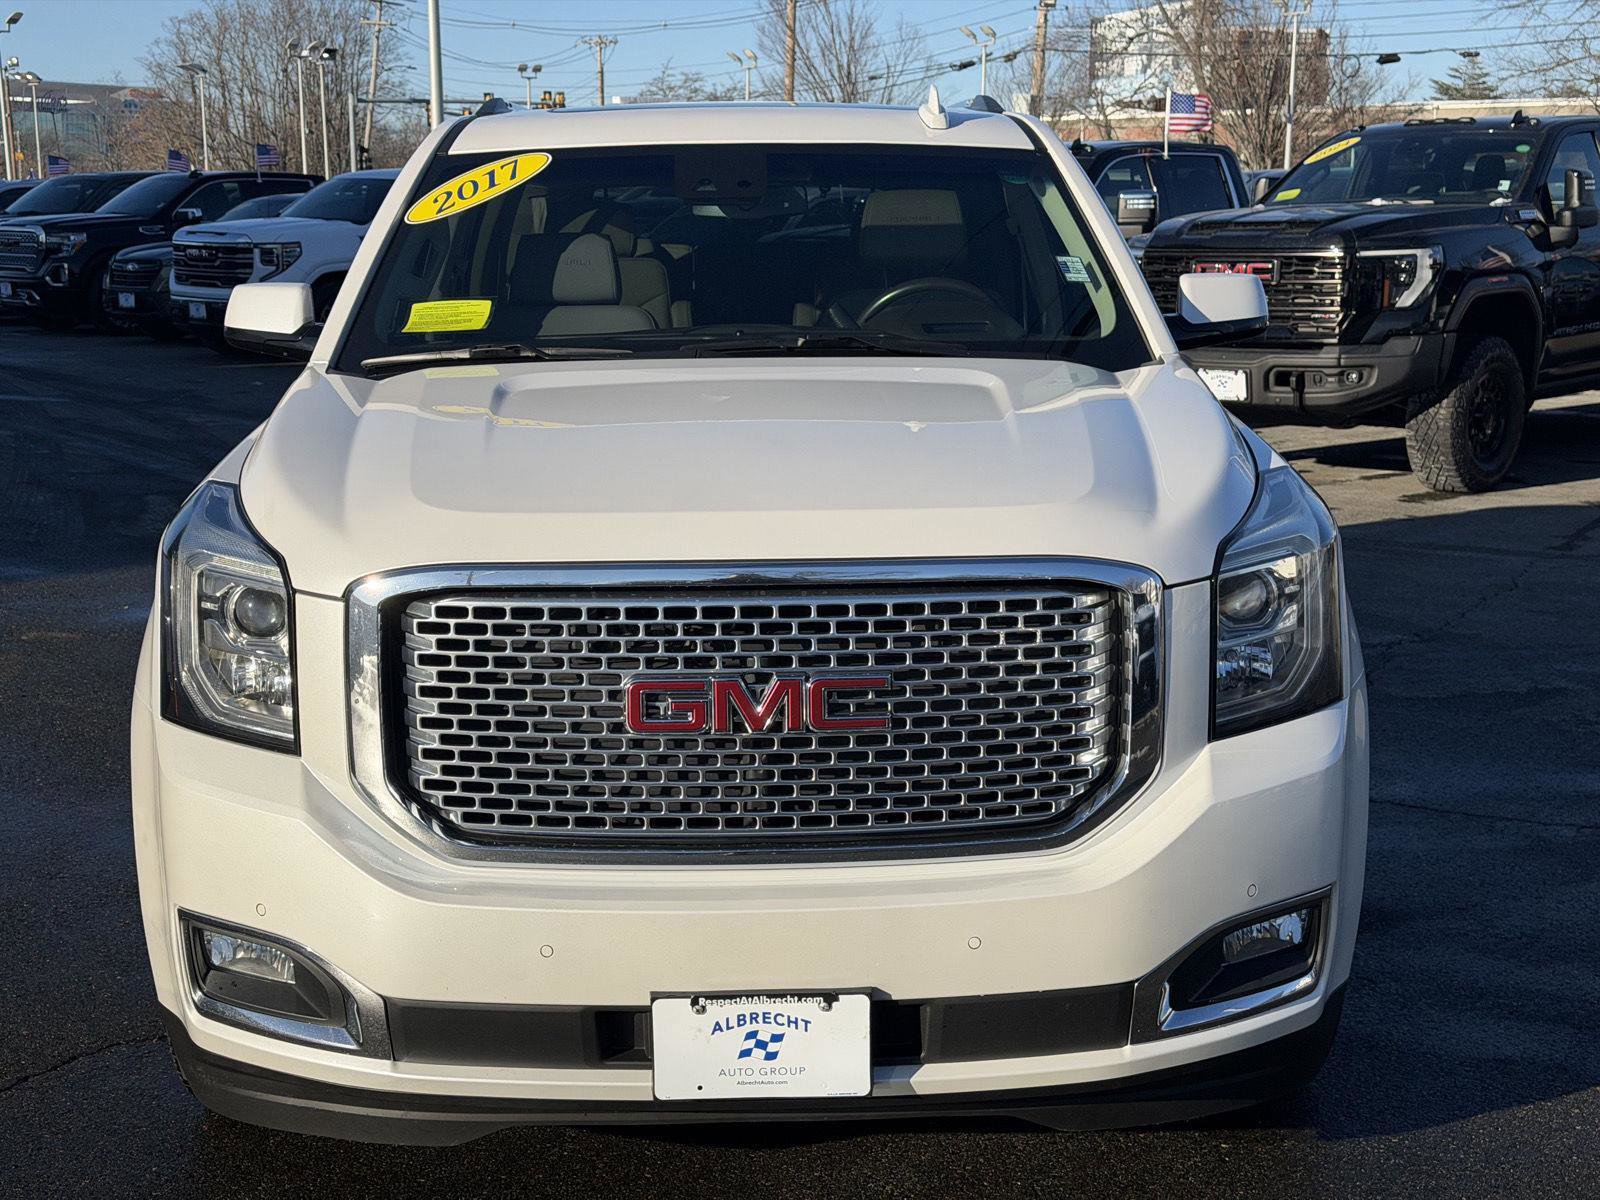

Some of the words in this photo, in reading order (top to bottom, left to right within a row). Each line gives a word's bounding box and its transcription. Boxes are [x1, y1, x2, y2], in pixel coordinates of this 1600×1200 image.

[432, 158, 519, 215] 2017
[624, 672, 892, 735] GMC
[698, 995, 824, 1007] RespectAtAlbrecht.com
[710, 1011, 812, 1036] ALBRECHT
[718, 1067, 755, 1077] AUTO
[759, 1066, 806, 1077] GROUP
